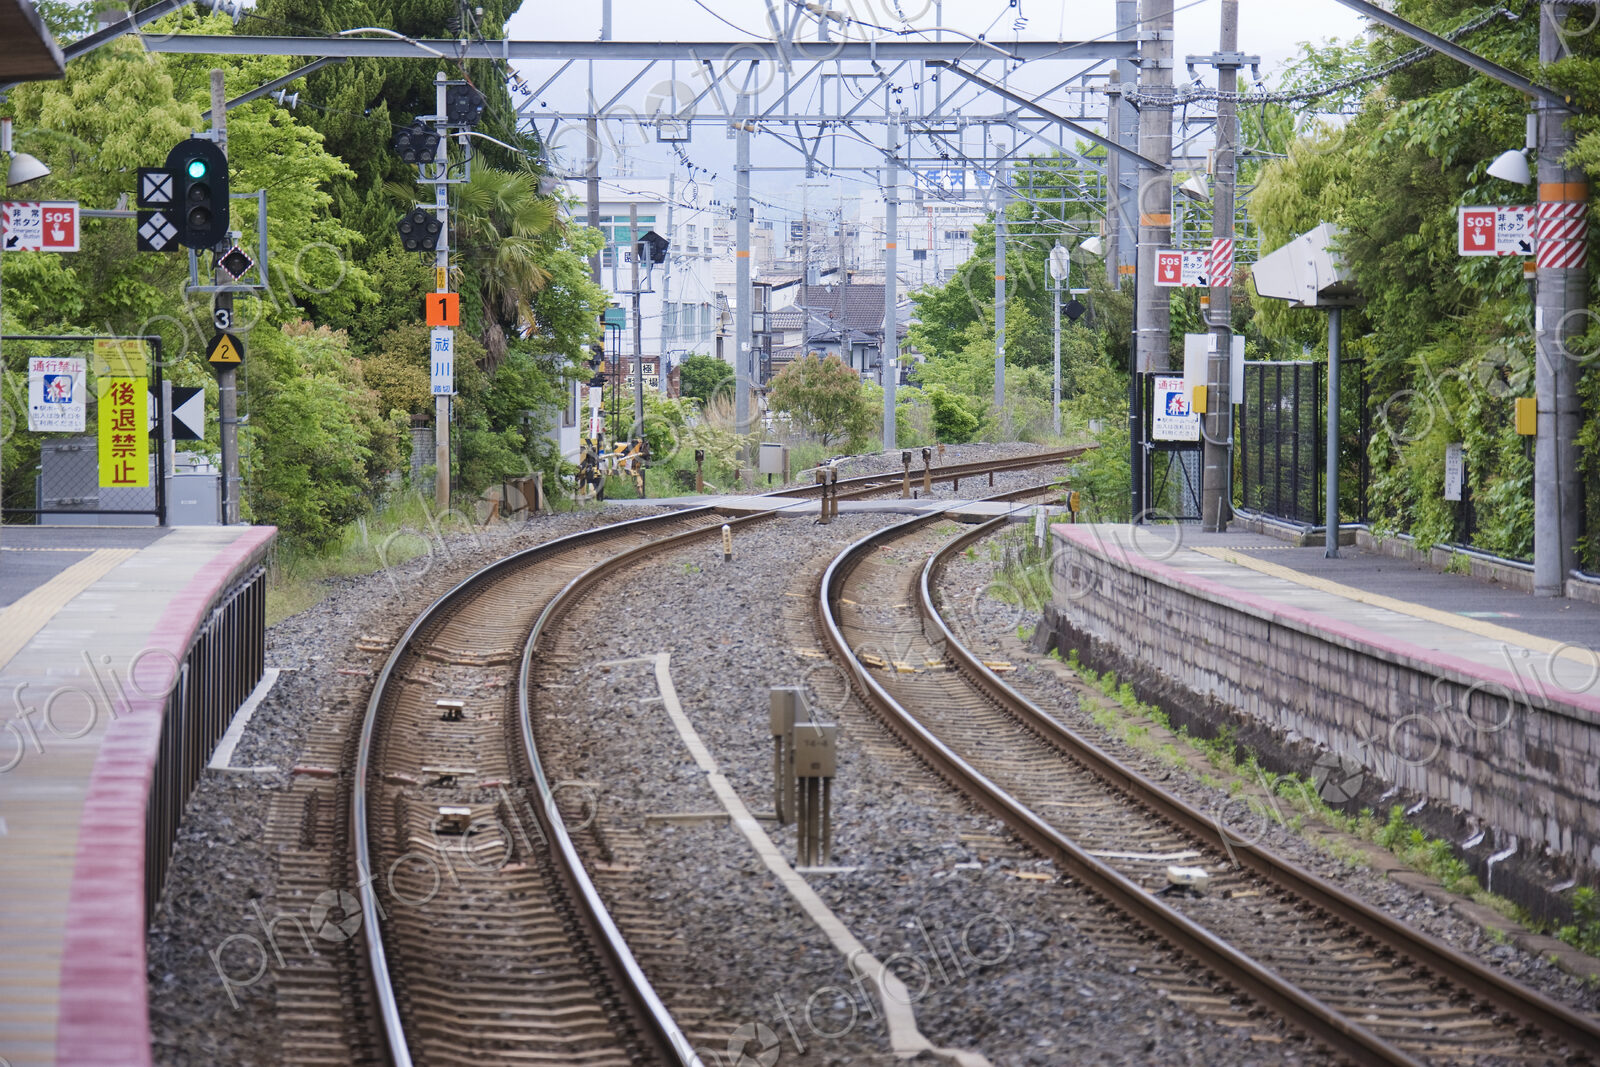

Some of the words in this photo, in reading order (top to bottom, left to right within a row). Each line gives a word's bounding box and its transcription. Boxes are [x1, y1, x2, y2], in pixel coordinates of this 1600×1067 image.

[13, 209, 39, 217] 非常
[45, 213, 71, 223] SOS
[13, 218, 39, 226] ボタン
[1467, 217, 1492, 227] SOS
[1498, 223, 1524, 231] ボタン
[1161, 257, 1179, 265] SOS
[439, 298, 446, 320] 1
[215, 309, 229, 329] 3
[221, 344, 229, 359] 2
[33, 360, 82, 373] 通行禁止
[111, 382, 136, 484] 後退禁止
